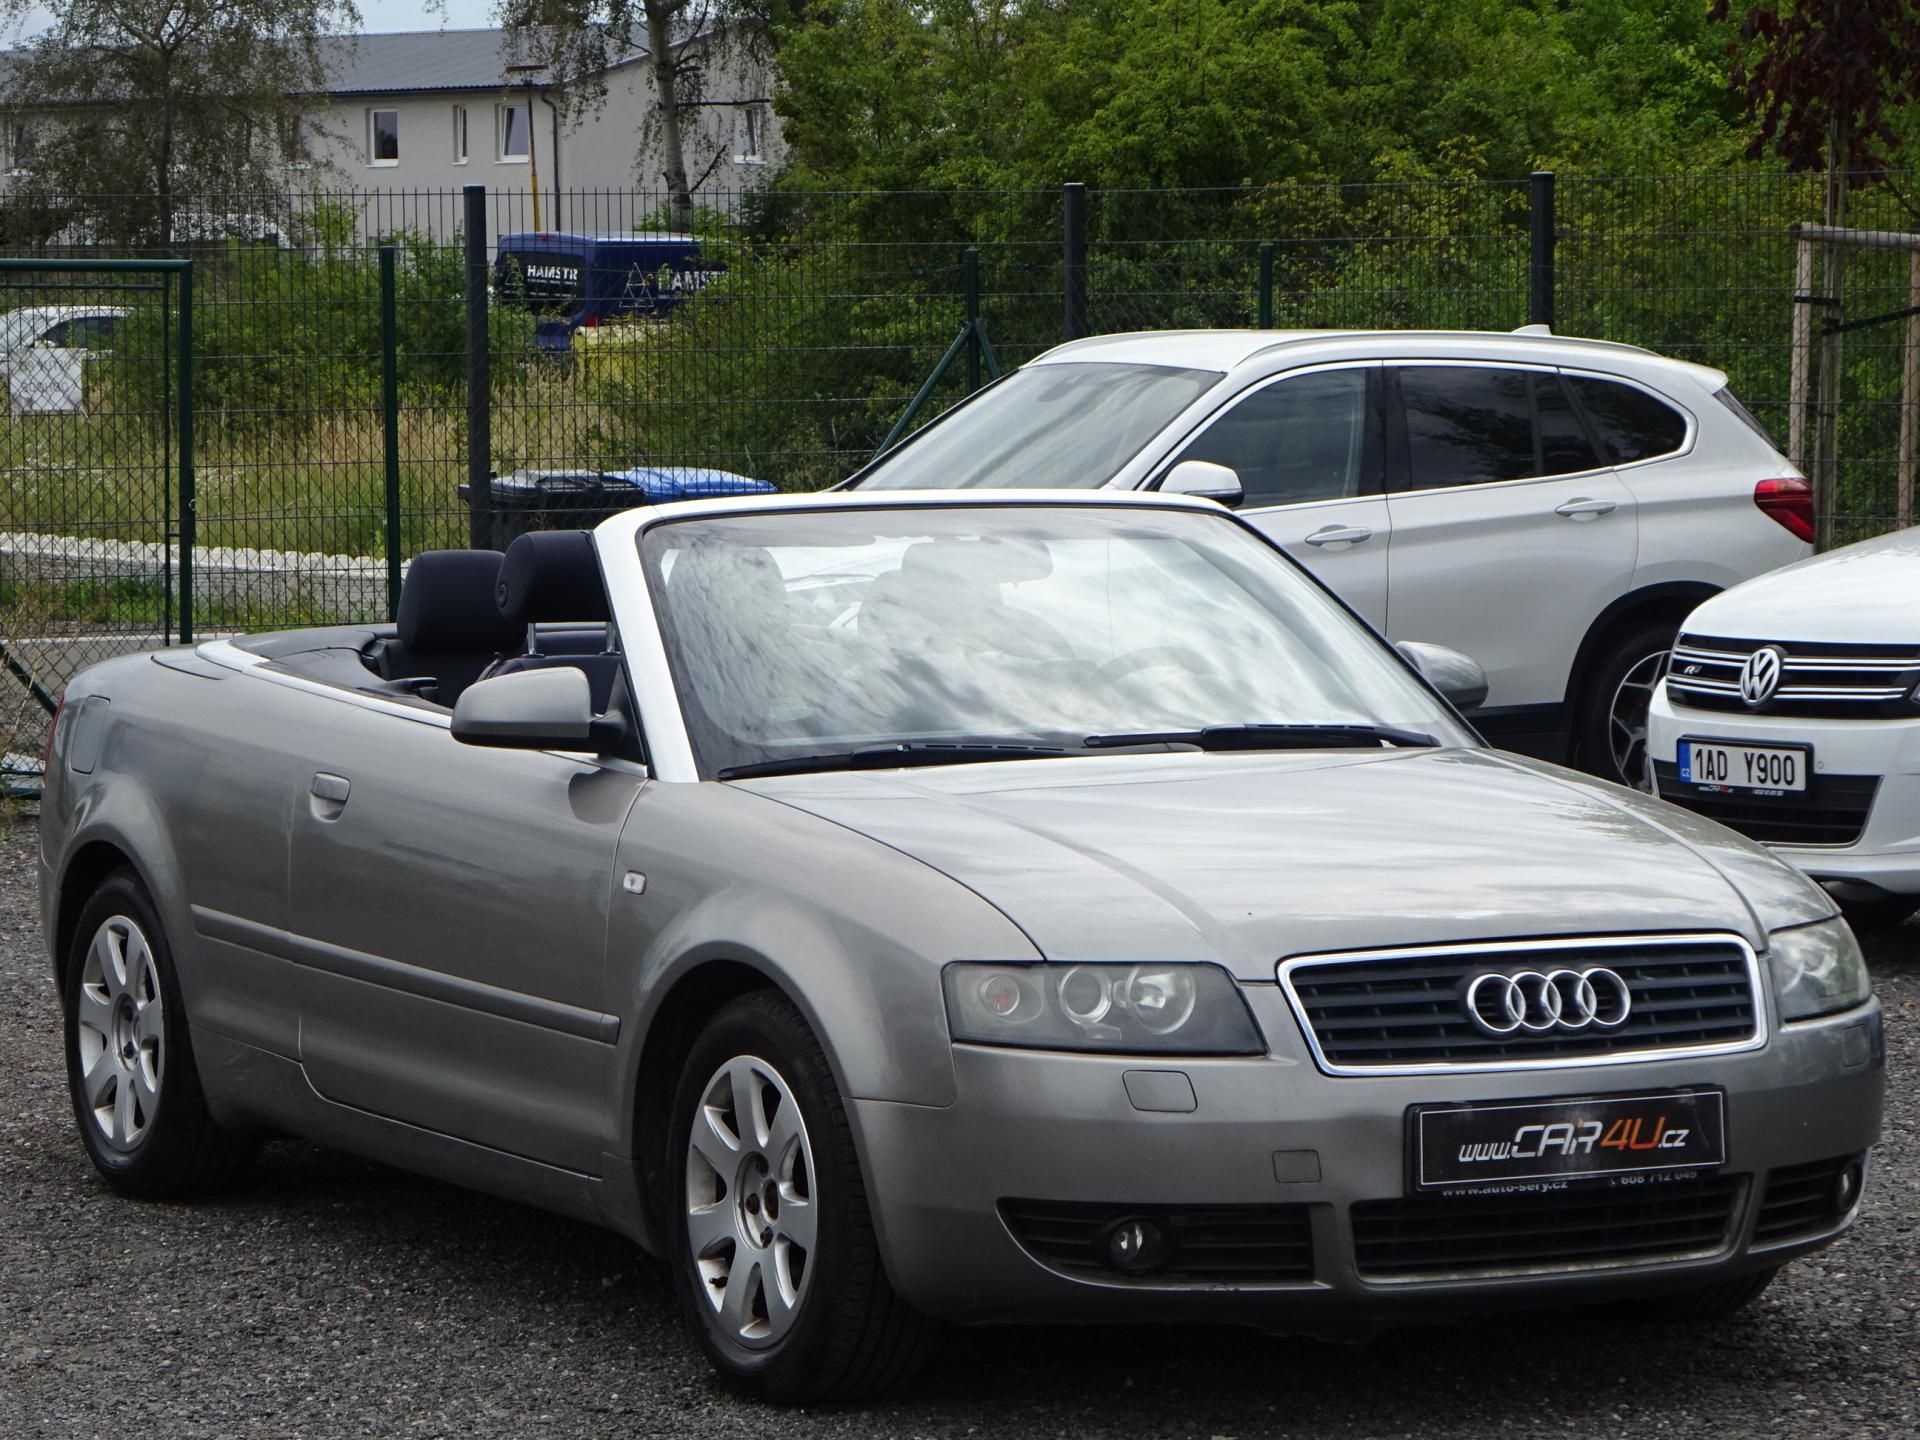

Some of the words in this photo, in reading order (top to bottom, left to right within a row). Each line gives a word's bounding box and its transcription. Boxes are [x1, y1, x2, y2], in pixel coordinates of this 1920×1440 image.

[1681, 767, 1691, 778] CZ
[1695, 748, 1728, 781] 1AD
[1744, 752, 1795, 786] Y900
